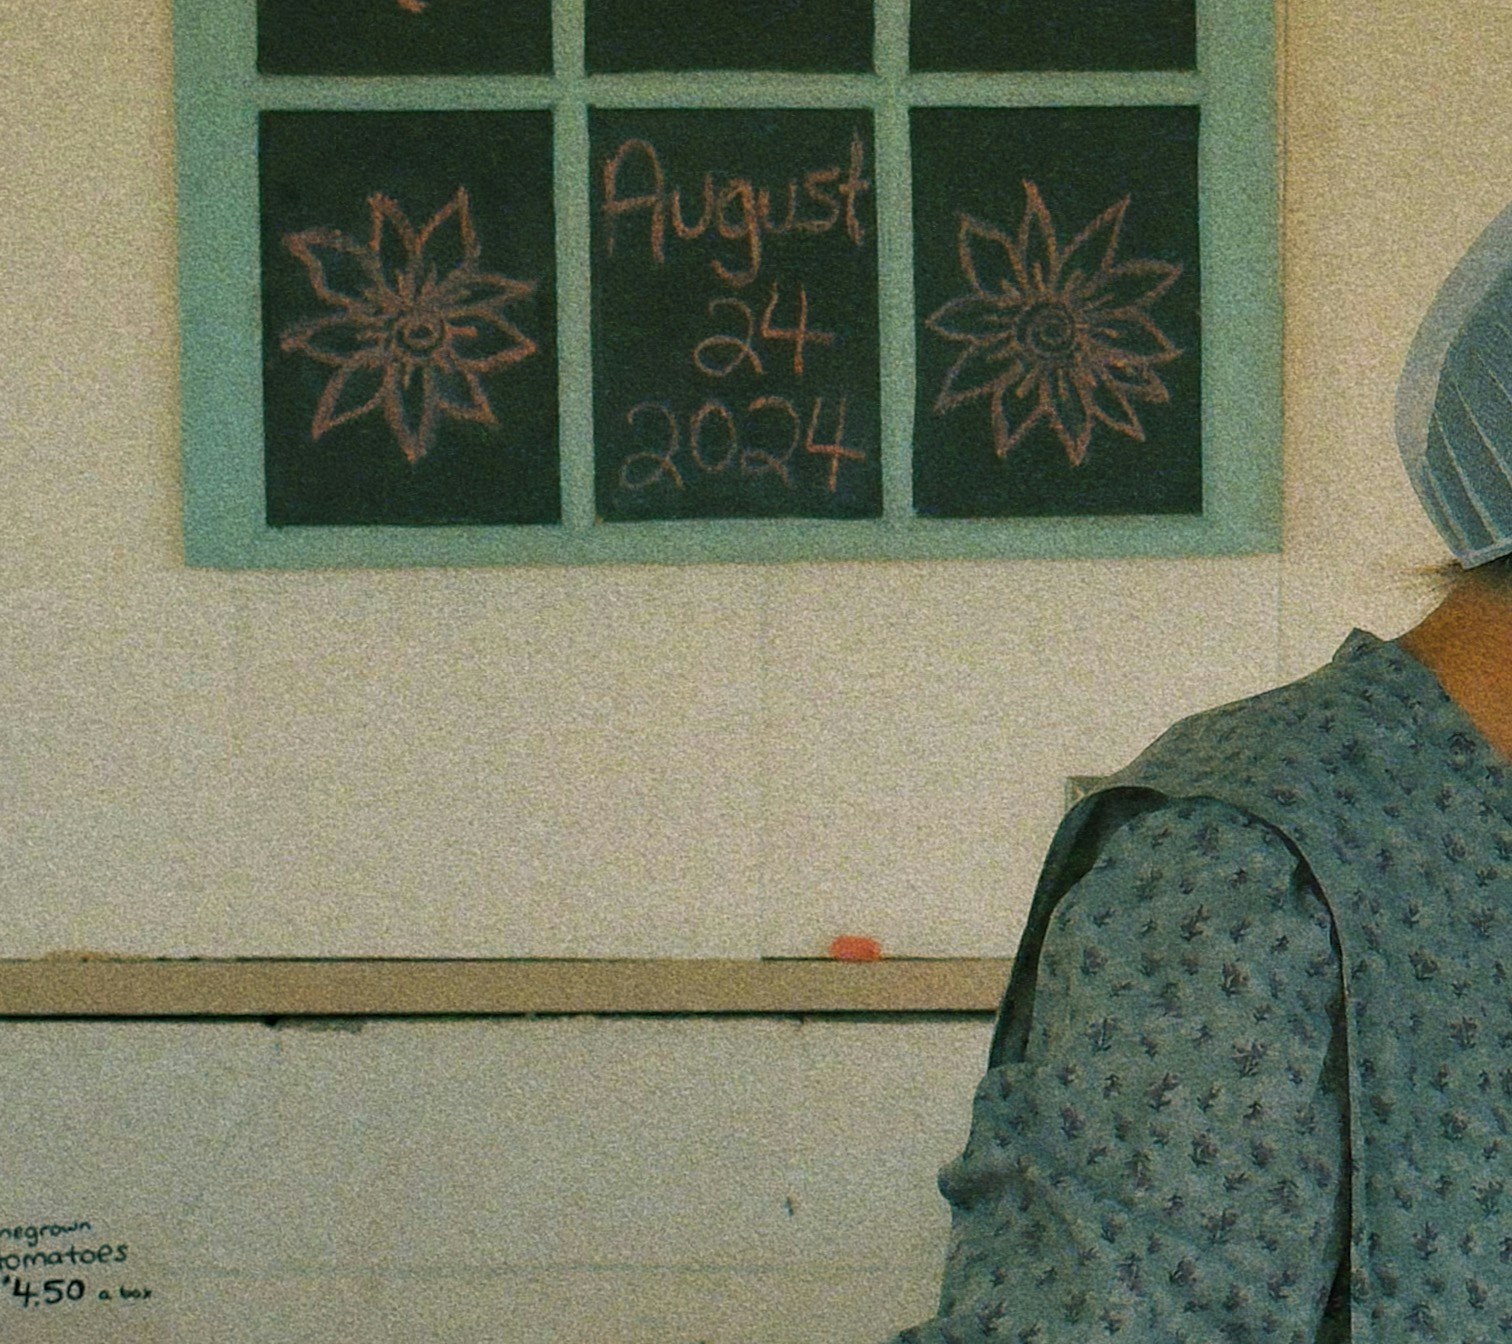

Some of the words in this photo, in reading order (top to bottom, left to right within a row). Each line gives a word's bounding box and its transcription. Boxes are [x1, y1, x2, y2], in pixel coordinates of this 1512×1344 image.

[602, 128, 871, 288] August
[694, 281, 836, 377] 24
[619, 394, 867, 492] 2024
[98, 1289, 112, 1301] a
[119, 1285, 153, 1301] box
